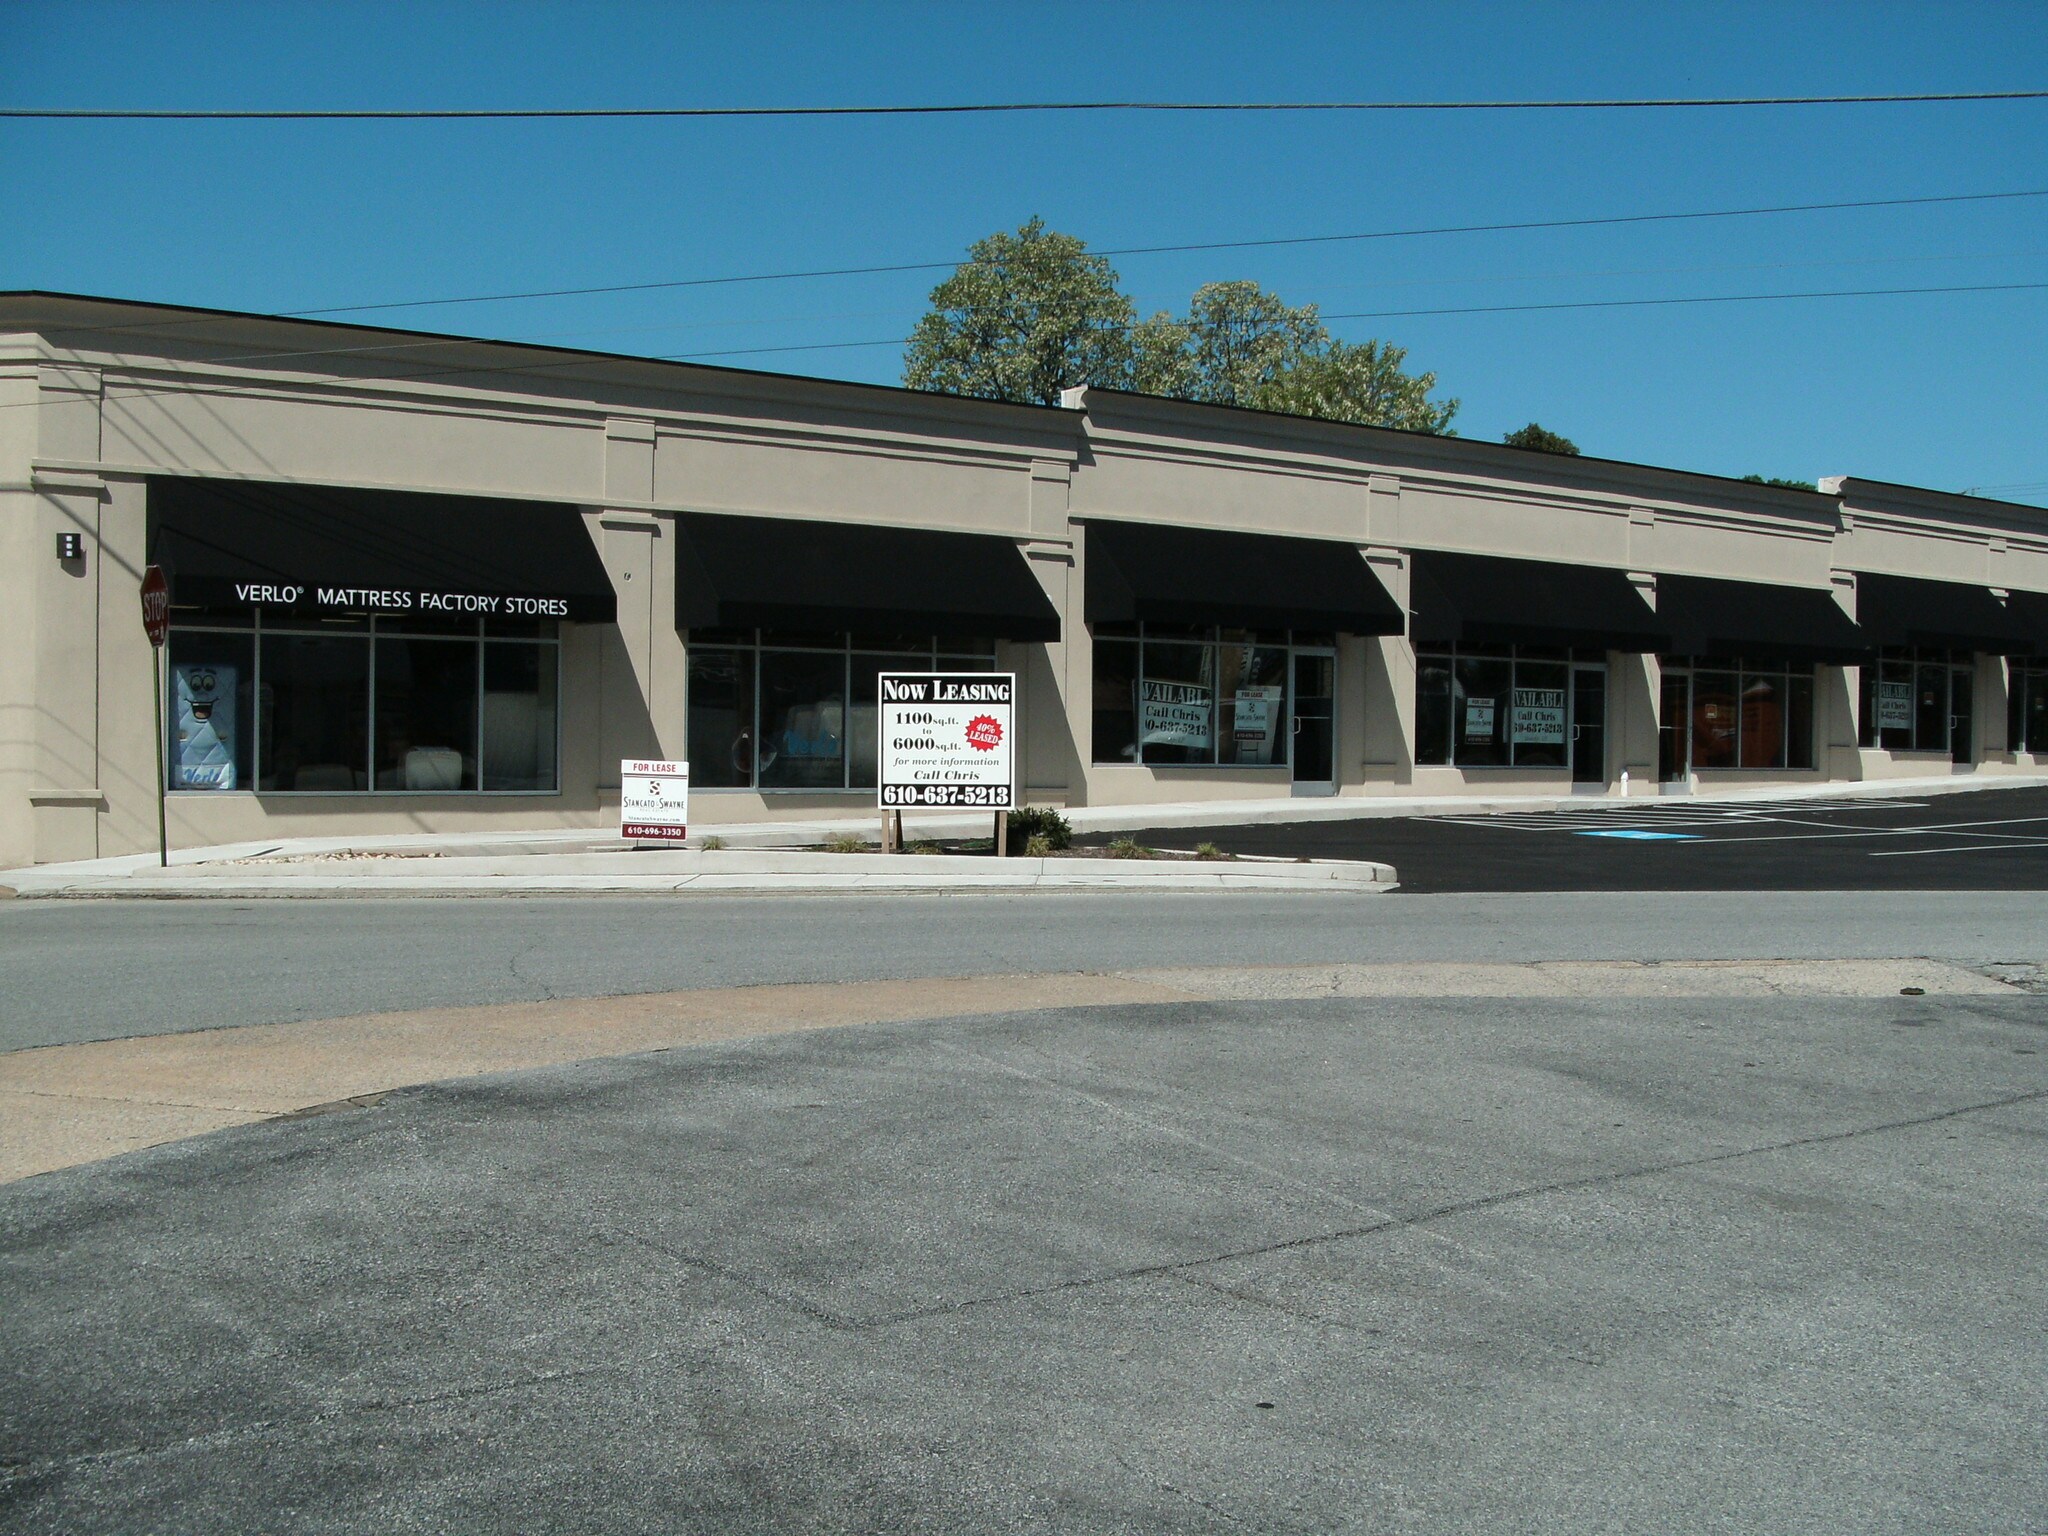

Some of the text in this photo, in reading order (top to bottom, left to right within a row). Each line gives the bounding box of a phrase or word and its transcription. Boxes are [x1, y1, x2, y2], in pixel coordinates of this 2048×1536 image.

[144, 592, 166, 622] STOP
[317, 588, 412, 608] MATTRESS
[420, 593, 500, 613] FACTORY
[505, 598, 568, 615] STORES
[883, 680, 1010, 700] NOW LEASING
[1142, 682, 1212, 707] VAILABL
[1146, 705, 1201, 721] Call Chris
[1517, 711, 1556, 721] Call Chris
[976, 722, 996, 734] 40%
[1144, 719, 1207, 736] 0-637-5213
[969, 731, 999, 744] LEASED
[633, 763, 676, 772] FOR LEASE
[893, 757, 1000, 767] for more information
[914, 770, 981, 780] Call Chris
[883, 786, 1009, 804] 610-637-5213
[627, 827, 682, 836] 610-696-3350
